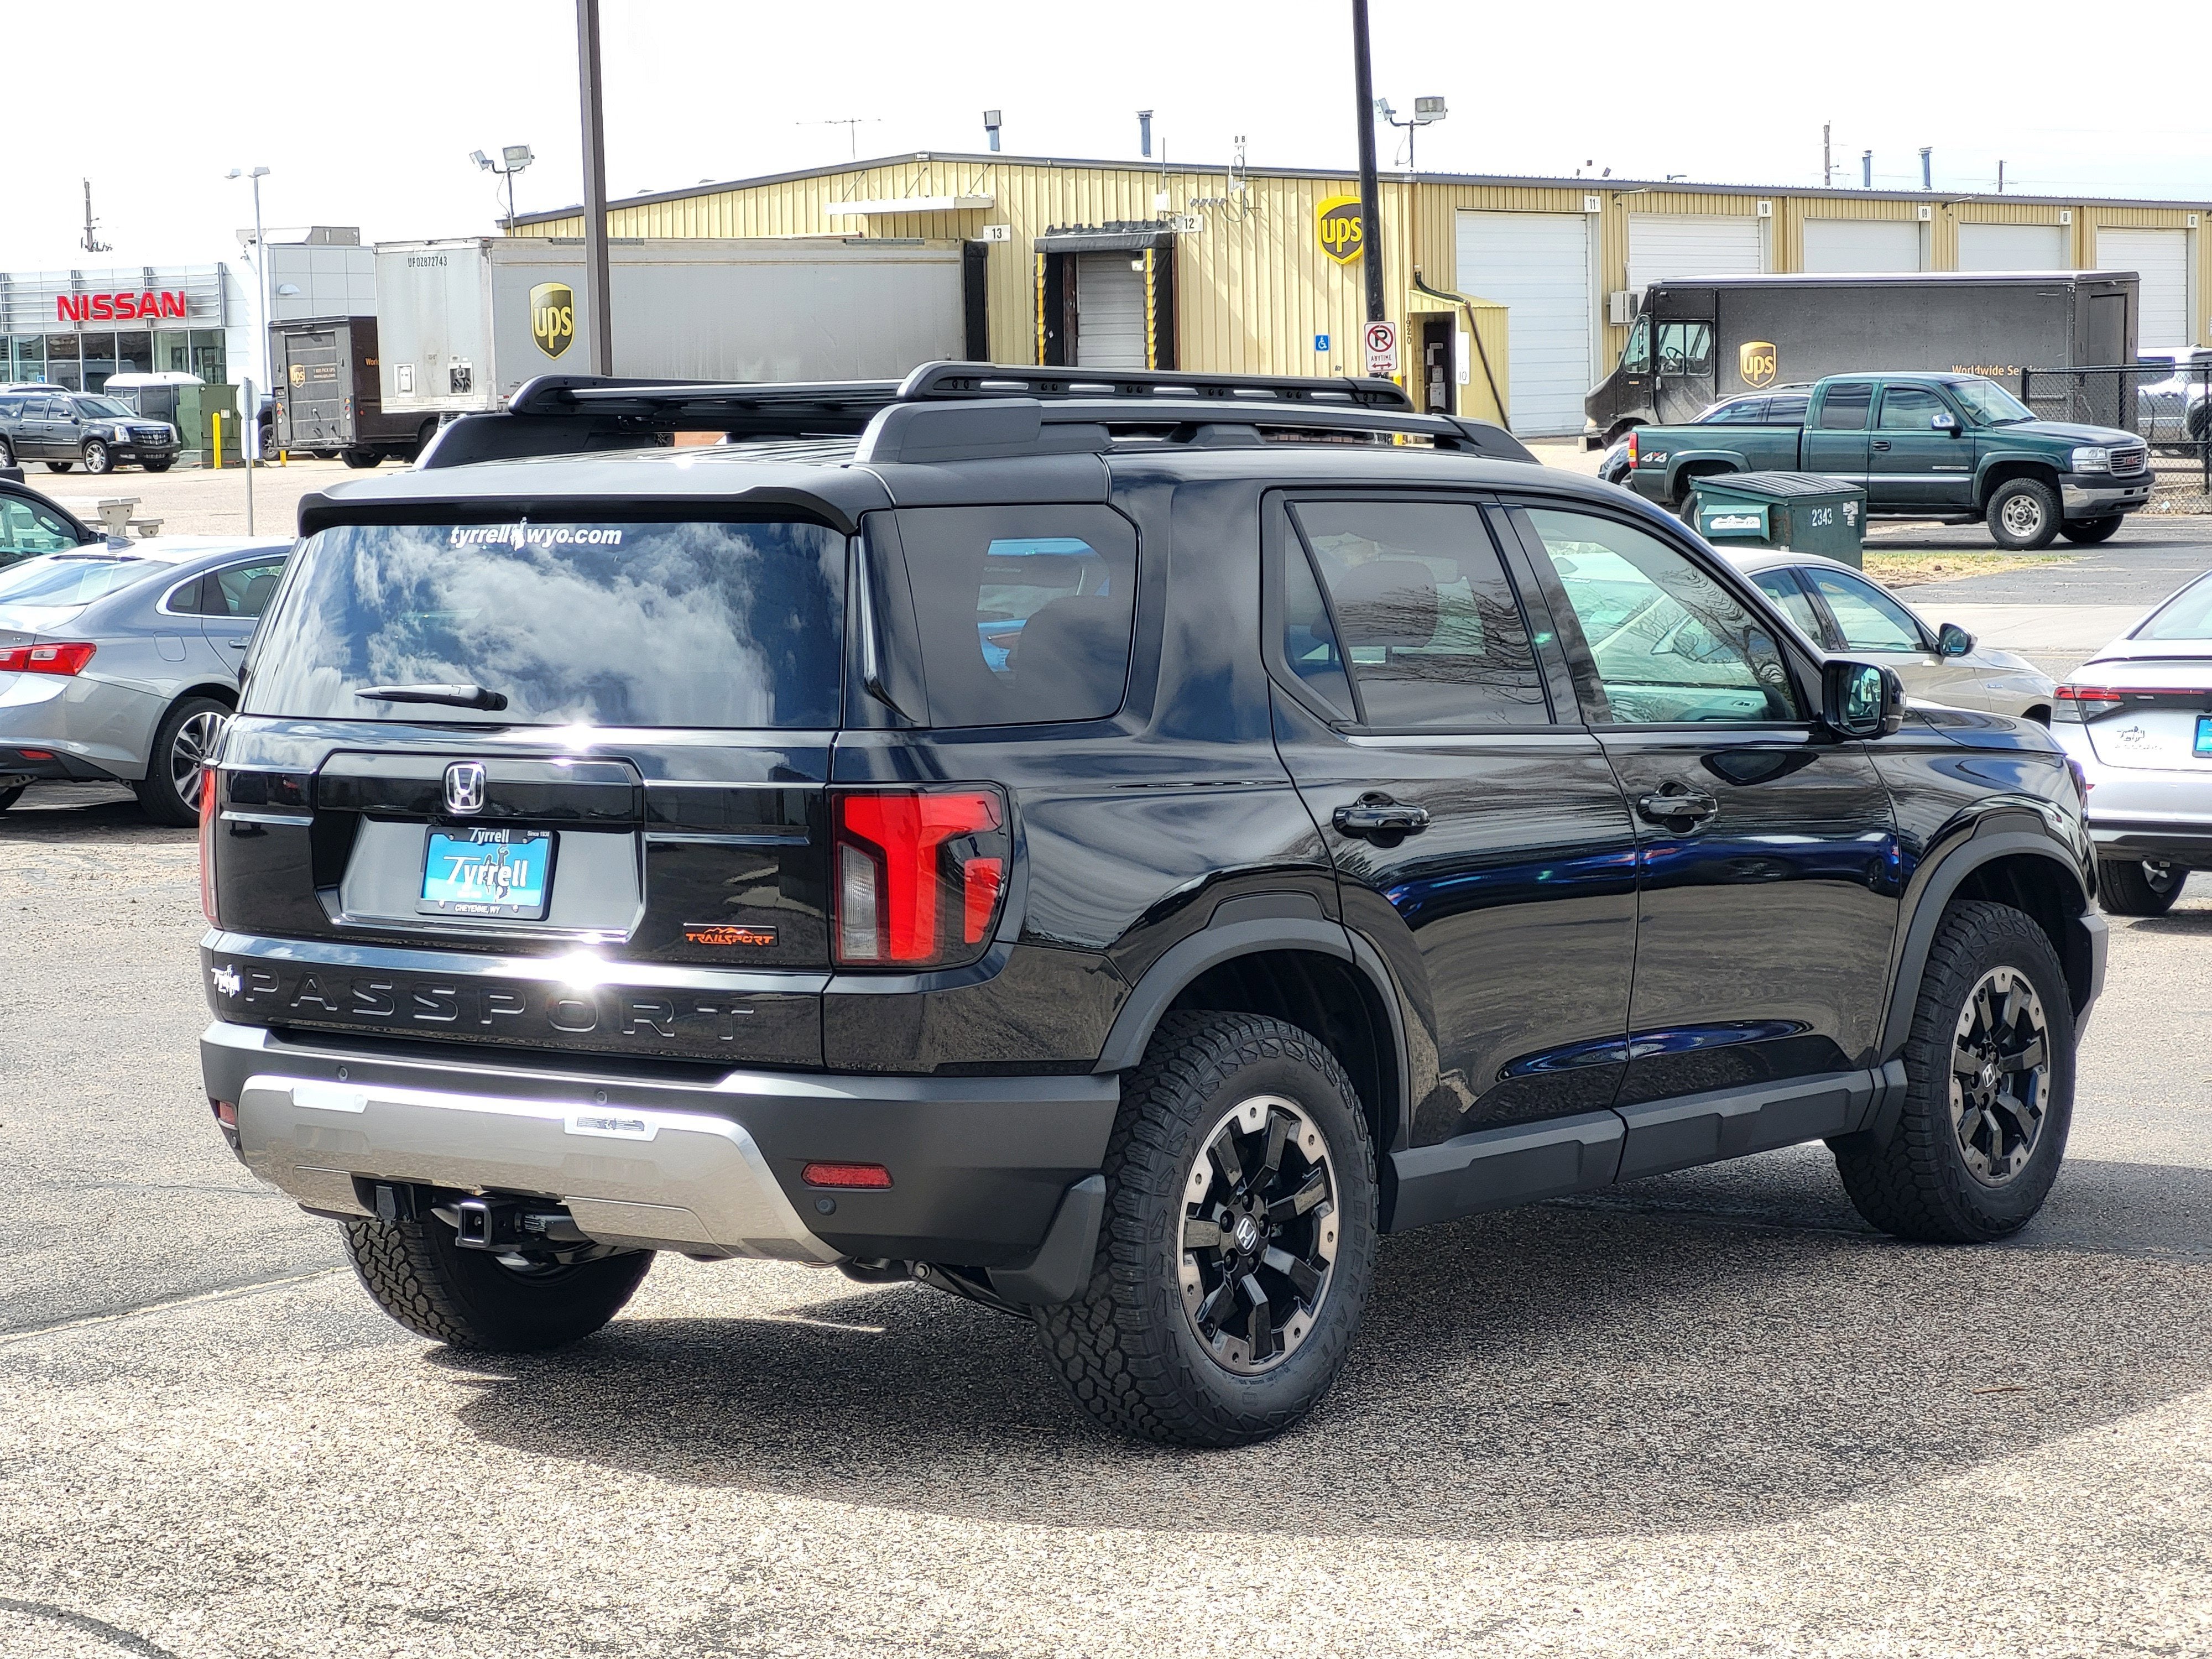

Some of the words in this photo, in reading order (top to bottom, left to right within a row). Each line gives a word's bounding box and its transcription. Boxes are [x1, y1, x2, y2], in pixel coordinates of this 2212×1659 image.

[1589, 199, 1596, 210] 11
[1762, 203, 1768, 214] 10
[1183, 218, 1194, 229] 12
[992, 228, 1003, 239] 13
[1322, 216, 1363, 253] ups
[56, 290, 186, 321] NISSAN
[534, 306, 572, 348] ups
[1743, 356, 1774, 381] ups
[1952, 364, 2005, 376] Worldwide
[291, 371, 304, 384] ups
[1811, 507, 1833, 527] 2343
[468, 827, 510, 844] Tyrrell
[443, 855, 529, 891] Tyrrell
[455, 903, 489, 914] CHEYENNE,
[490, 905, 502, 914] WY
[685, 932, 774, 946] TRAILSPORT
[242, 966, 756, 1042] PASSPORT
